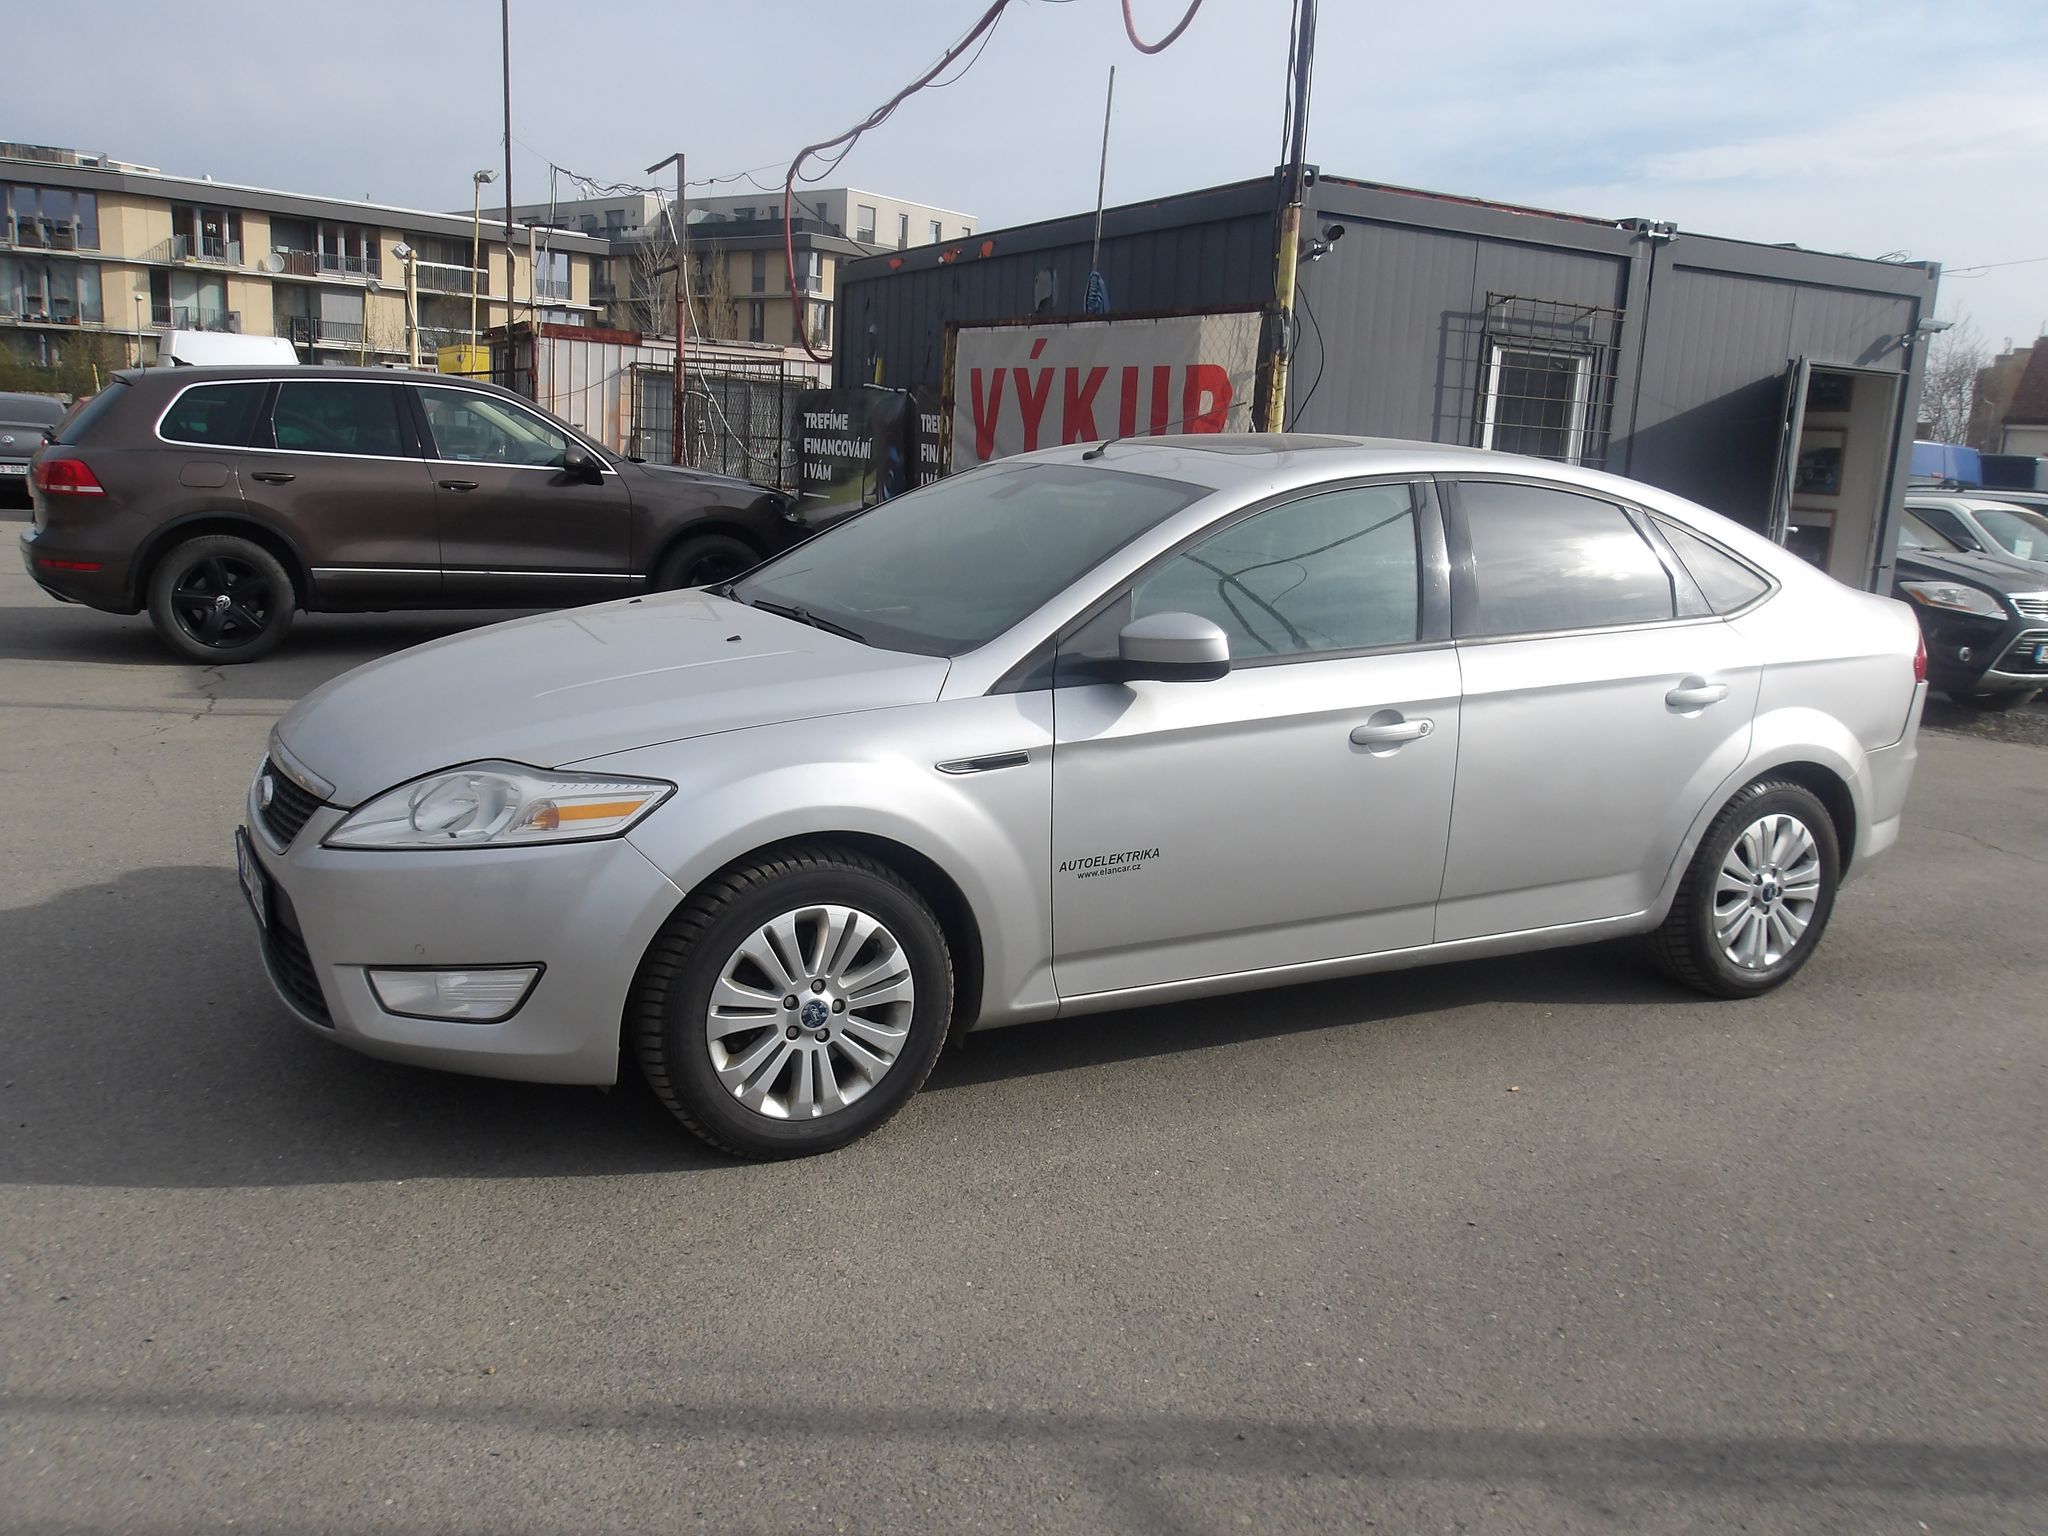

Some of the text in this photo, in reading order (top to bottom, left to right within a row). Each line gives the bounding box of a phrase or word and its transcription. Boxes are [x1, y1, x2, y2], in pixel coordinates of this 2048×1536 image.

[971, 338, 1233, 461] VÝKUP
[803, 410, 848, 431] TREFÍME
[803, 437, 873, 459] FINANCOVÁNÍ
[803, 459, 831, 481] I VÁM
[1058, 847, 1160, 873] AUTOELEKTRIKA
[1077, 863, 1141, 879] www.elancar.cz
